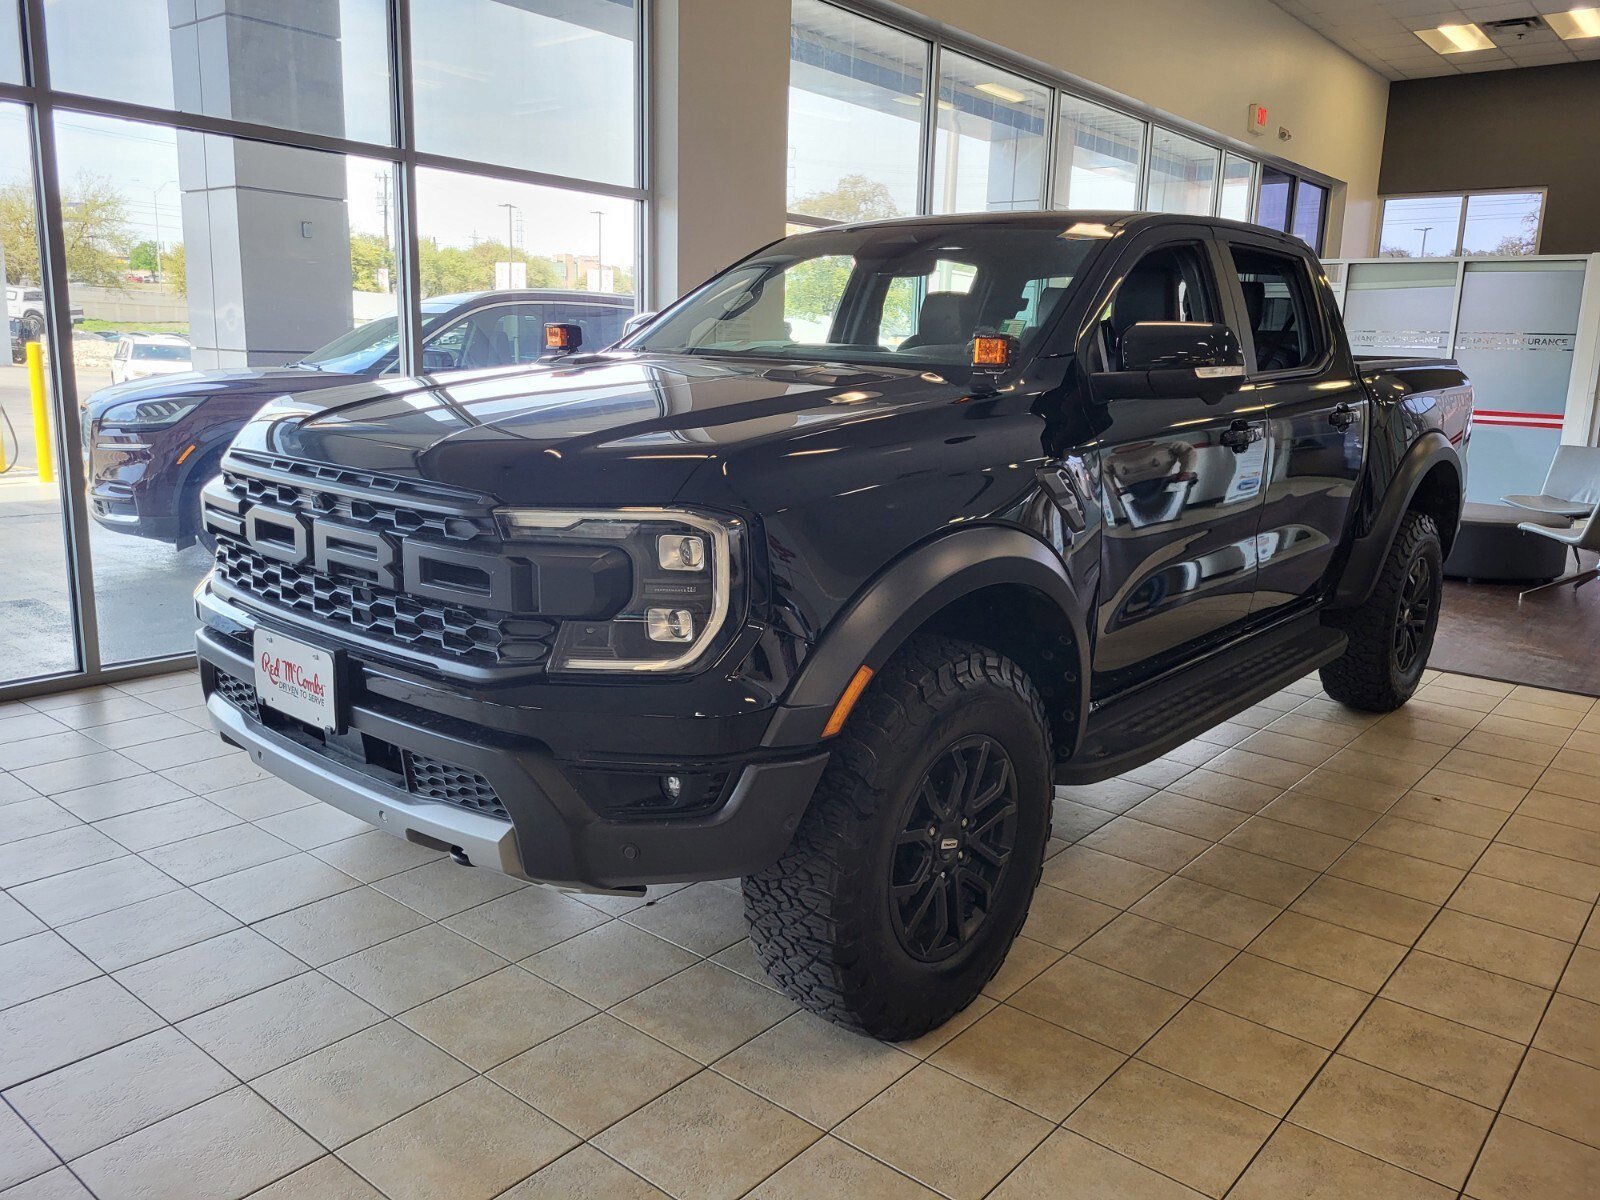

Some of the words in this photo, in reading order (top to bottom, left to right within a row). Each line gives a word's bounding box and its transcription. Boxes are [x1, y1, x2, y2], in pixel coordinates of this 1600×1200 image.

[1512, 338, 1569, 346] INSURANCE
[201, 484, 512, 613] FORD
[262, 652, 280, 685] Red
[282, 660, 325, 697] McCombs
[278, 681, 299, 696] DRIVEN
[300, 690, 307, 699] TO
[308, 693, 325, 707] SERVE
